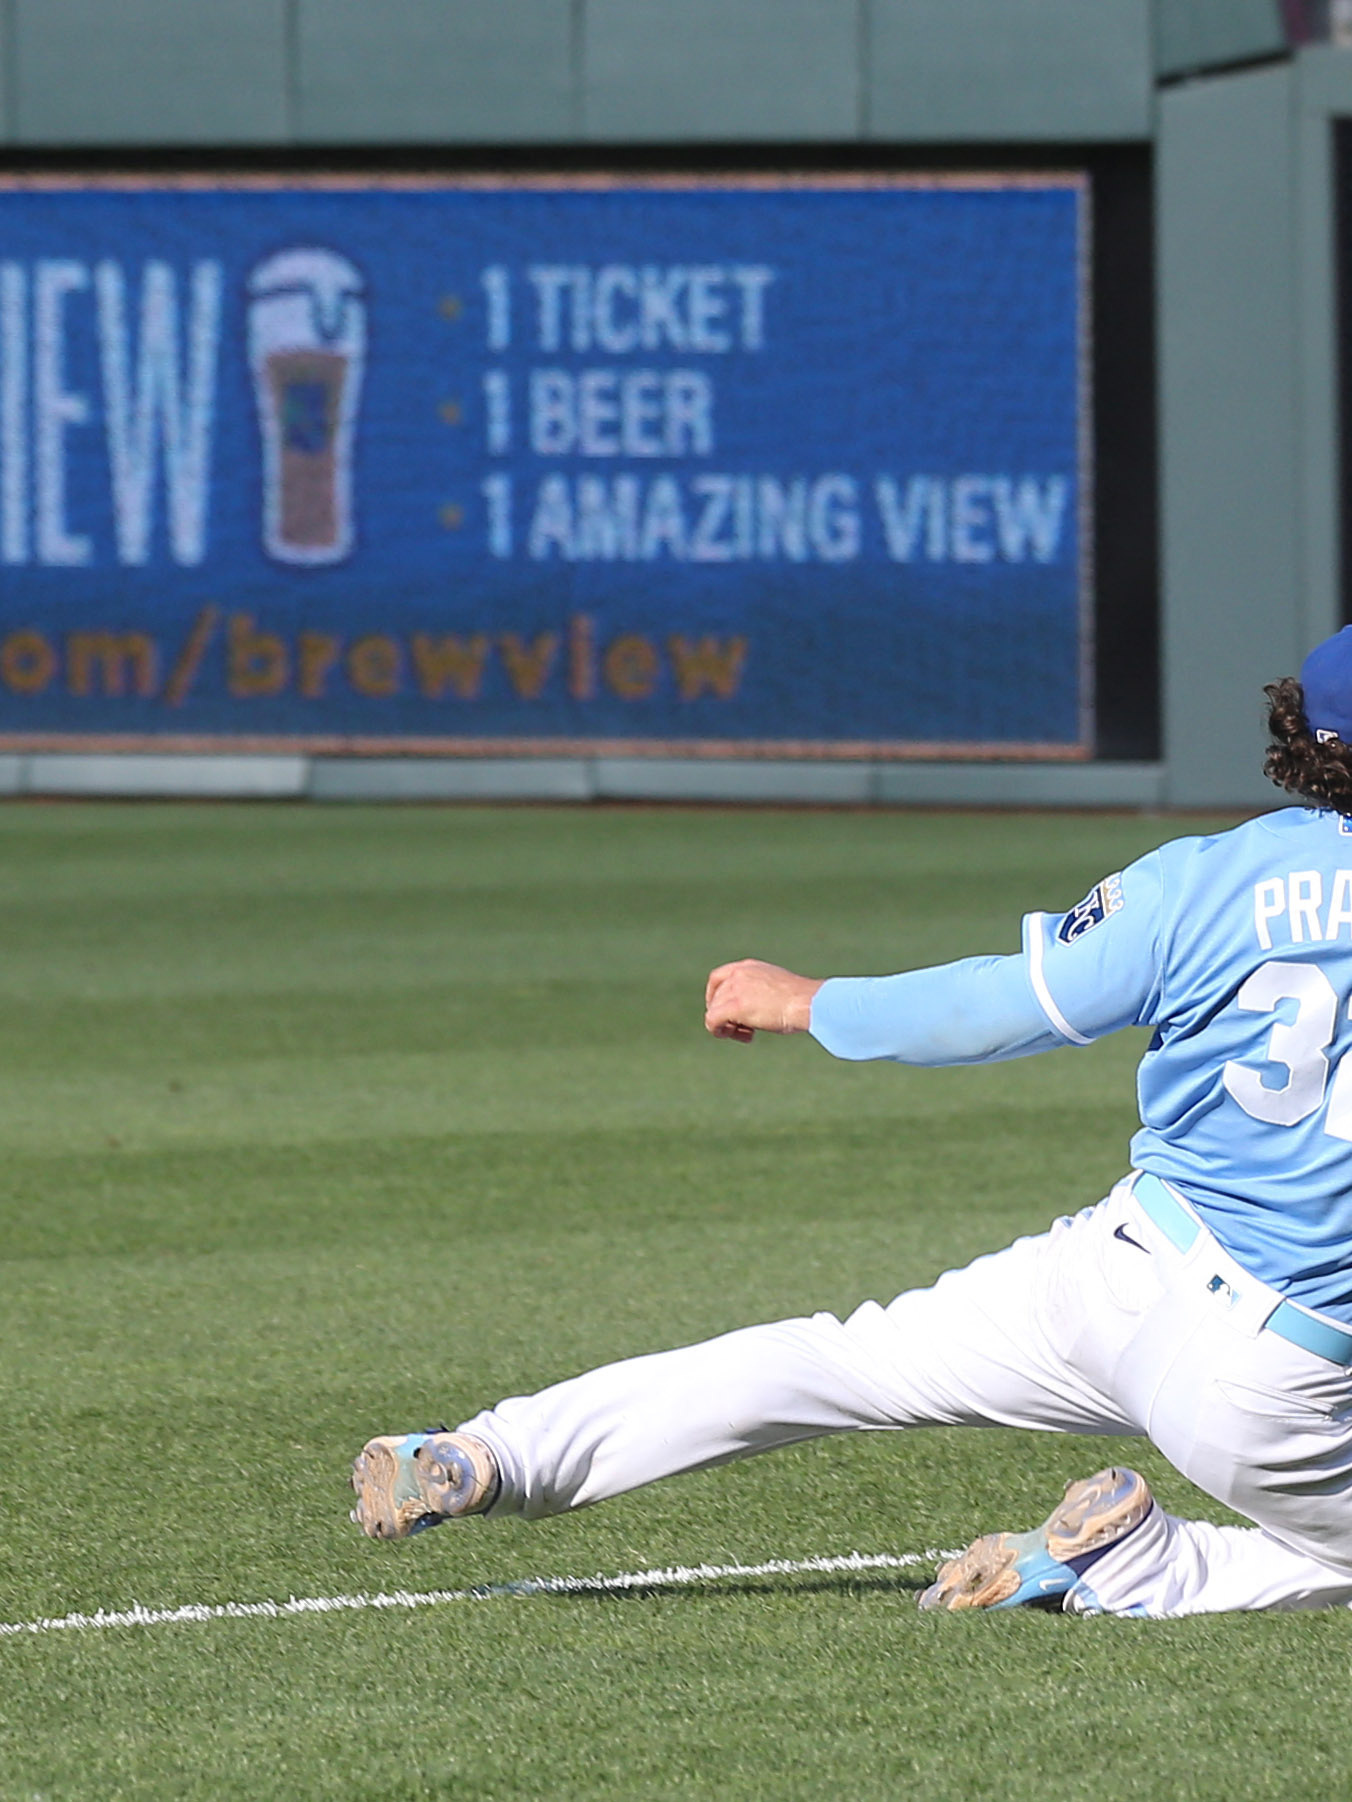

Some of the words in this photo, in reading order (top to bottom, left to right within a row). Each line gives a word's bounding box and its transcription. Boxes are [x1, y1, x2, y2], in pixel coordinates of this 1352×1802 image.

[482, 265, 510, 352] 1
[528, 265, 773, 353] TICKET
[482, 370, 509, 456] 1
[530, 369, 712, 457] BEER
[482, 473, 512, 560] 1
[528, 473, 861, 561] AMAZING
[876, 472, 1066, 563] VIEW
